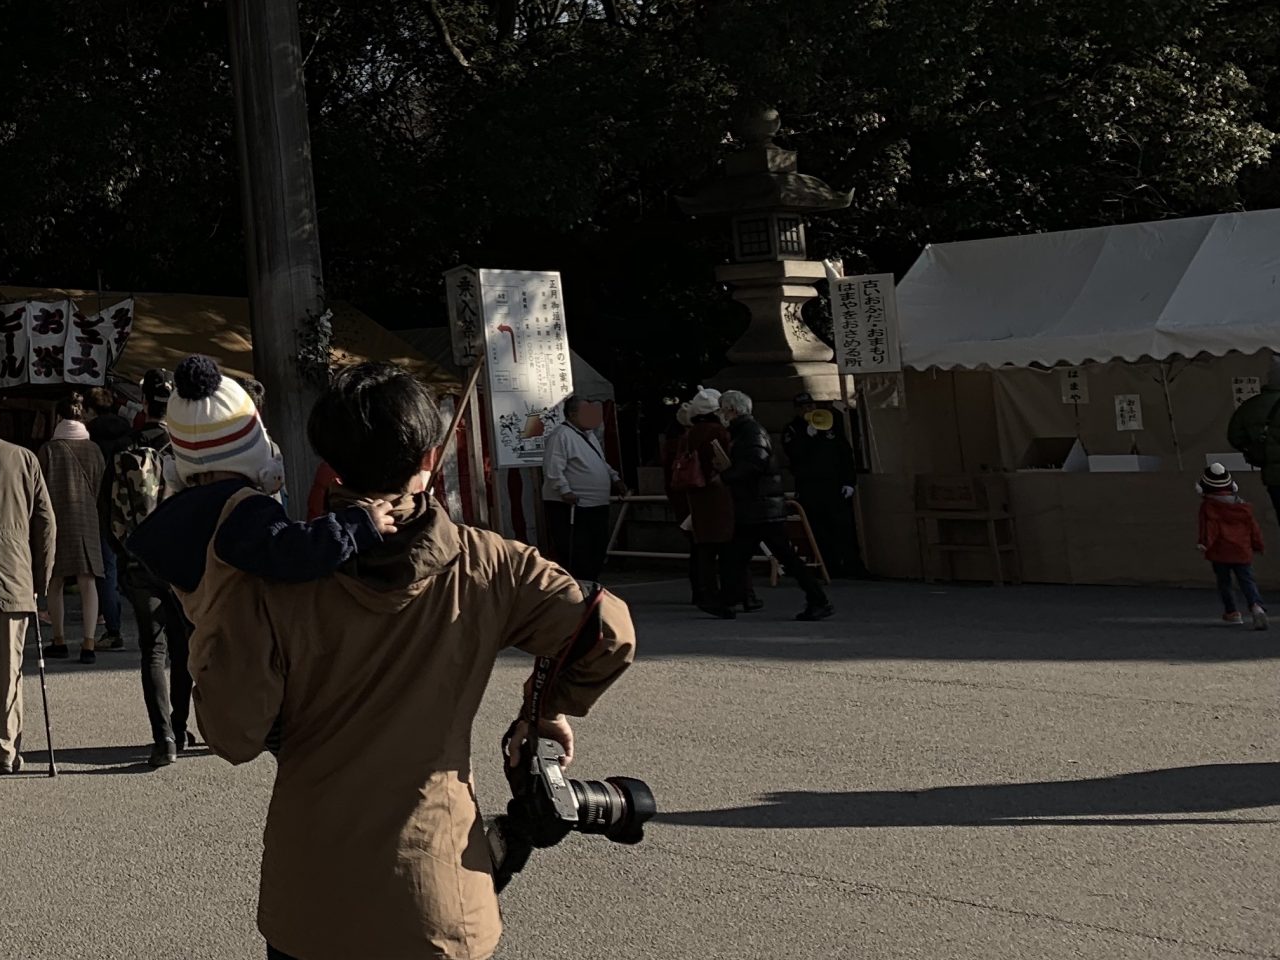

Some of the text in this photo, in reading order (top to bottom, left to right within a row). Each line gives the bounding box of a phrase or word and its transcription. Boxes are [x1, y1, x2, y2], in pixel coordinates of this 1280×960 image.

[32, 307, 64, 377] お茶
[838, 283, 863, 367] はまやをおさめる所
[862, 280, 885, 364] 古いおふだ・おまもり
[1067, 370, 1081, 401] はまや
